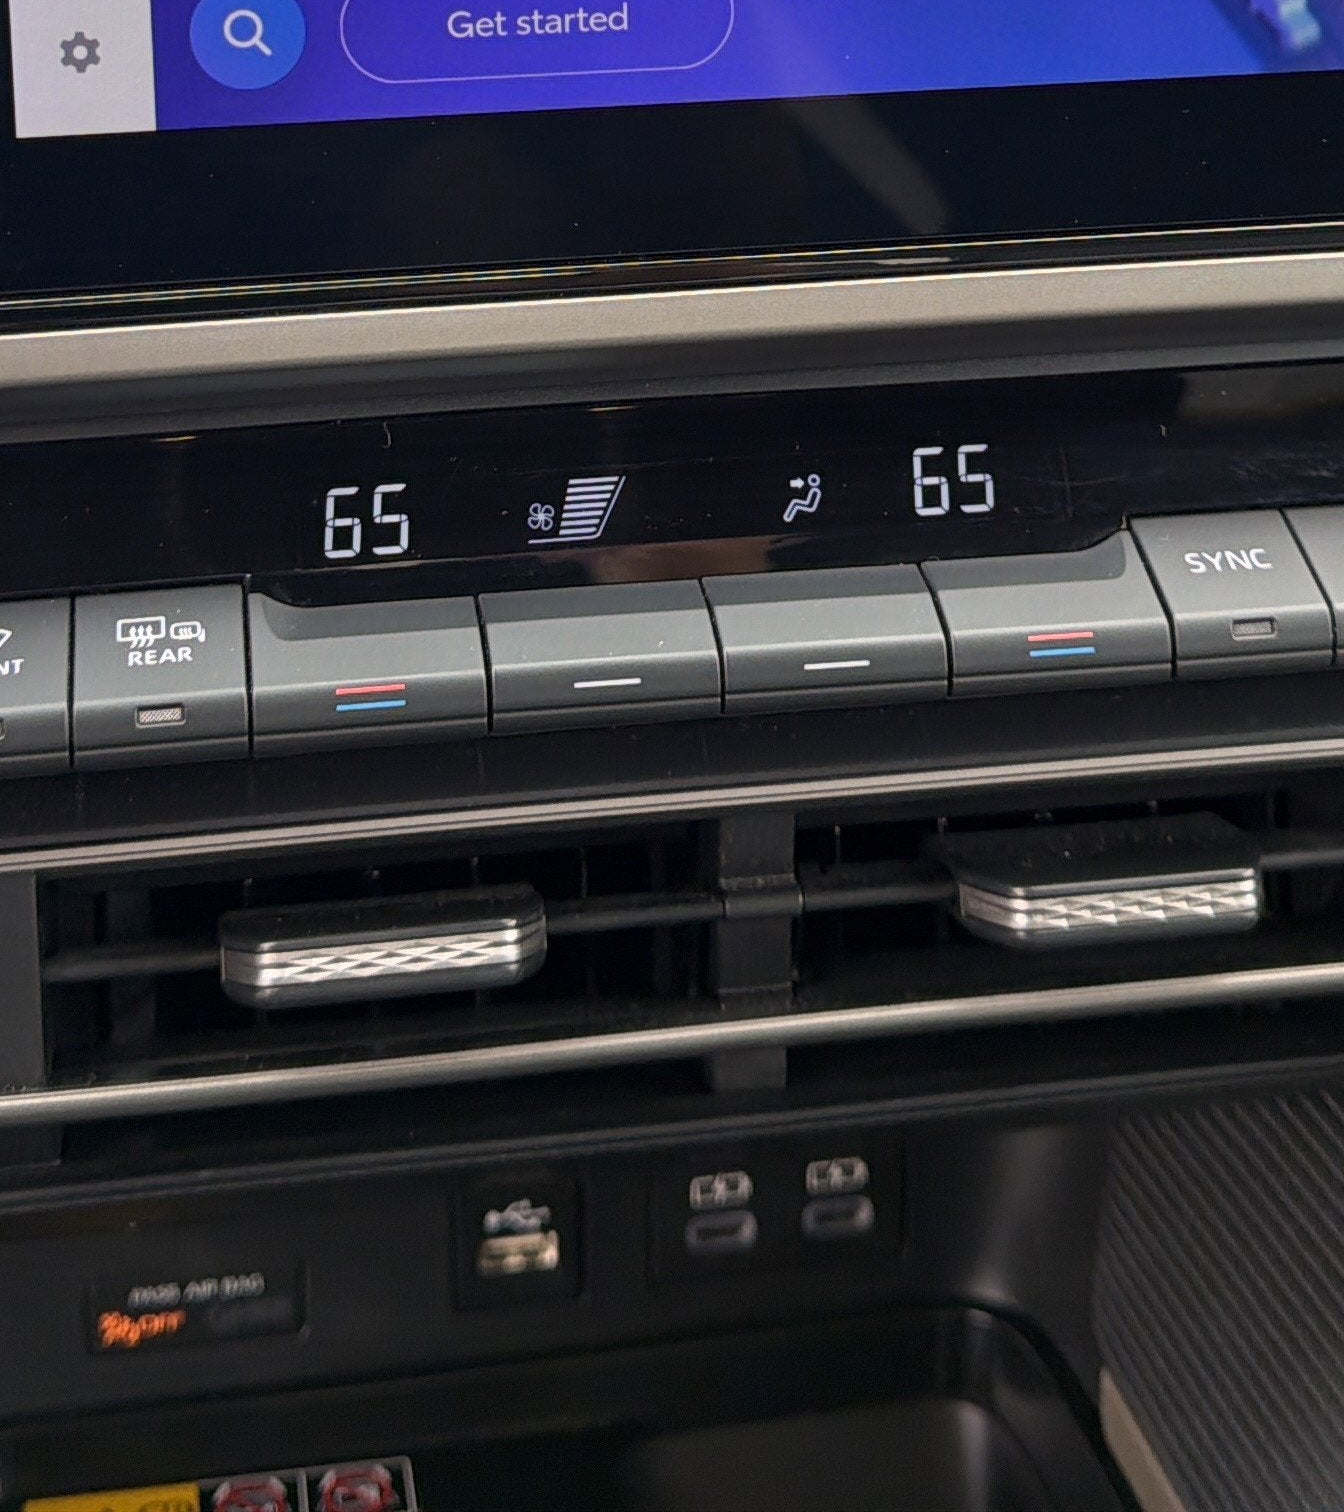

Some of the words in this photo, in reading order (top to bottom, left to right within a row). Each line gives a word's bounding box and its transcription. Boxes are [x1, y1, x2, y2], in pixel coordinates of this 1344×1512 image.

[447, 10, 508, 39] Get
[516, 2, 629, 36] started
[912, 443, 995, 517] 65
[324, 483, 410, 563] 65
[1184, 548, 1273, 574] SYNC
[127, 642, 193, 667] REAR
